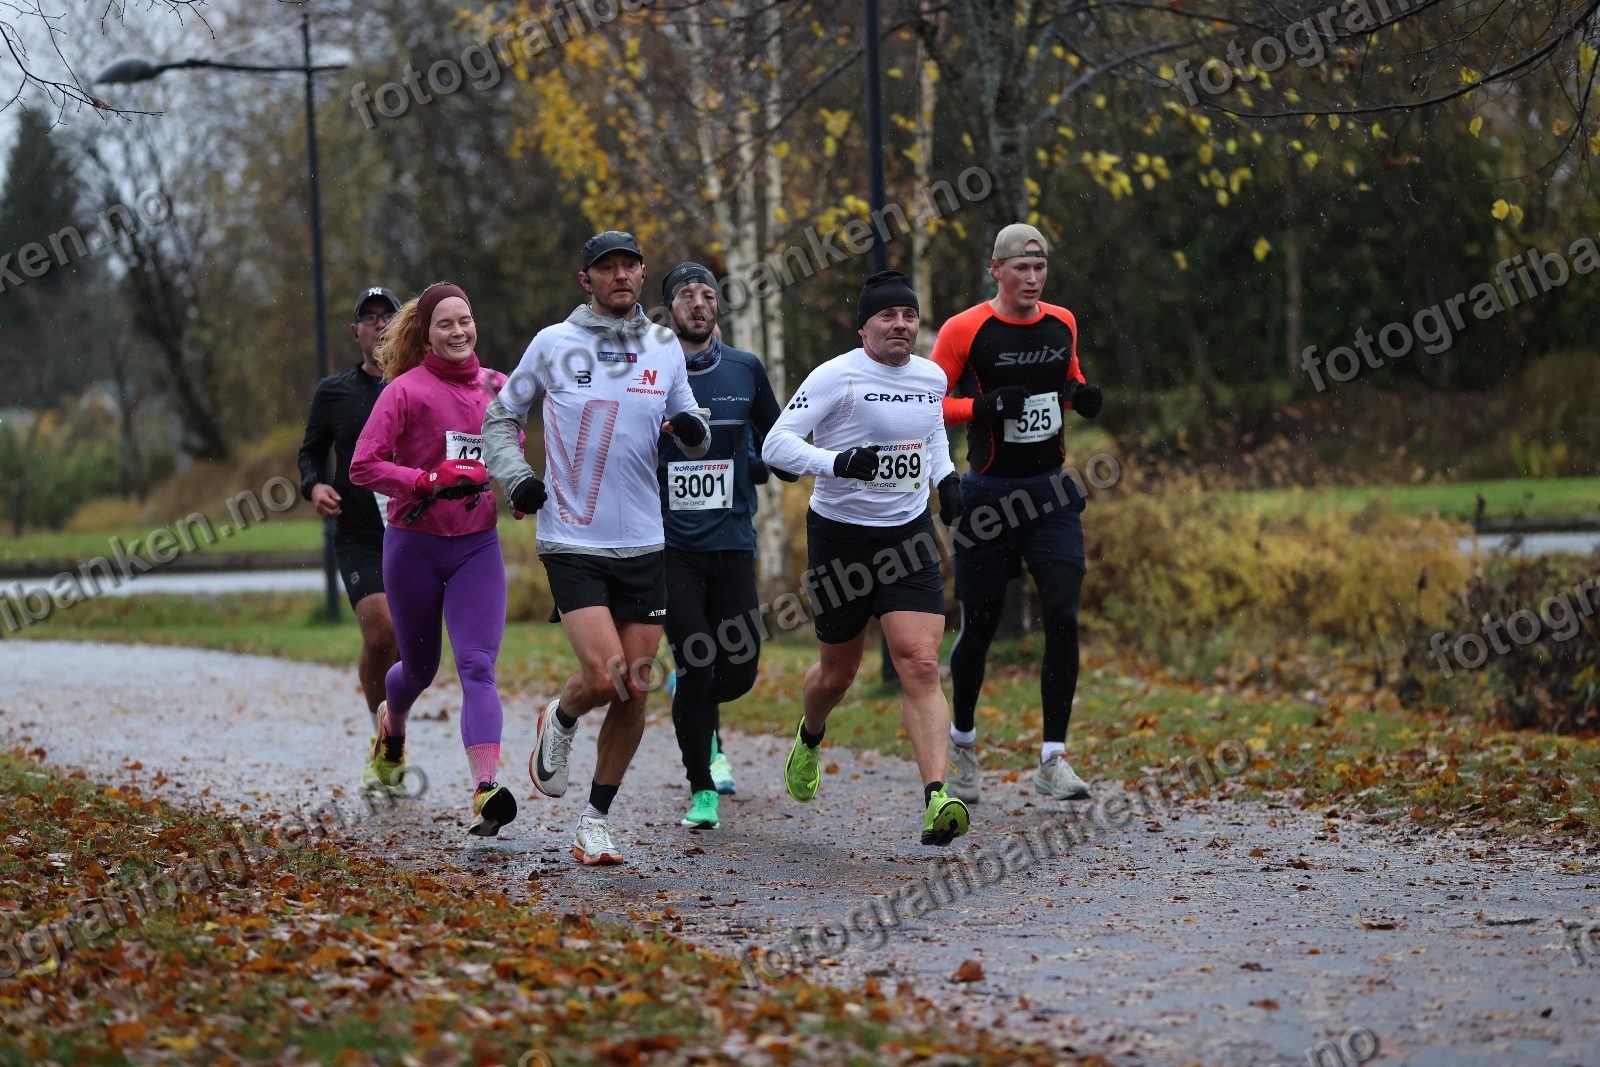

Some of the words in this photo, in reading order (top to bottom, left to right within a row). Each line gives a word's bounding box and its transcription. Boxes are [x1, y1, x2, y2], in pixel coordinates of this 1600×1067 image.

[864, 393, 926, 403] CRAFT
[1017, 408, 1052, 433] 525
[674, 464, 730, 472] NORGESTESTEN
[873, 453, 921, 480] 369
[674, 473, 726, 499] 3001
